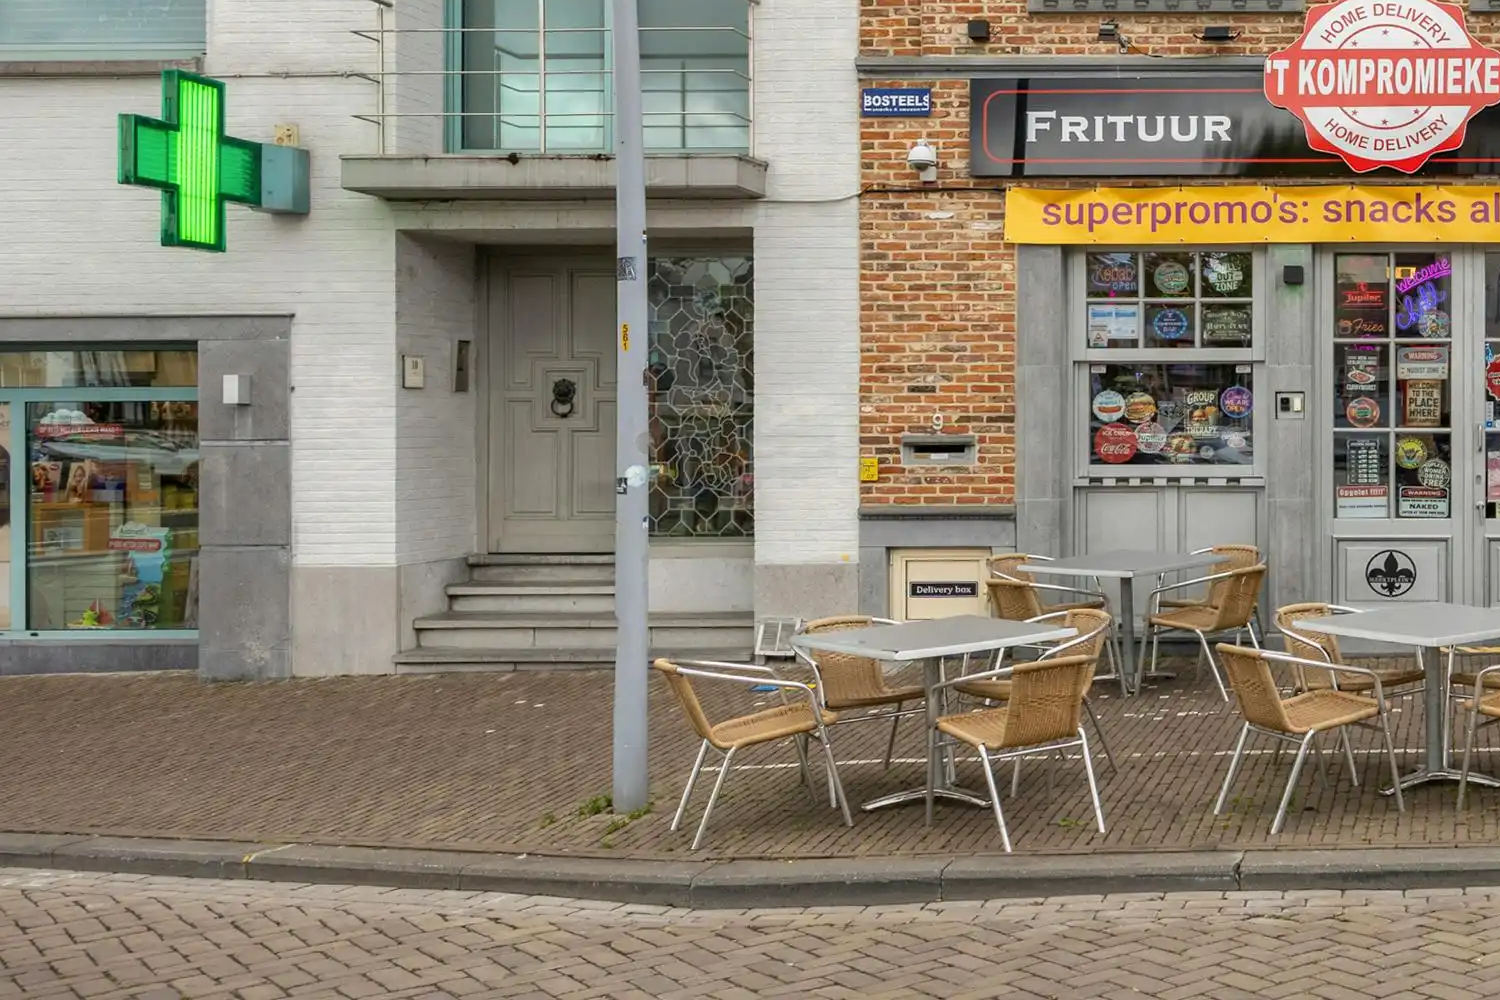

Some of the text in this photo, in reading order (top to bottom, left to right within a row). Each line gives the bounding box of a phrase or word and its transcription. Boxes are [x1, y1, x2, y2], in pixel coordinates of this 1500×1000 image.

[1320, 3, 1450, 44] HOME DELIVERY
[1298, 58, 1500, 96] KOMPROMIEKE
[864, 95, 929, 106] BOSTEELS
[1026, 110, 1232, 143] FRITUUR
[1324, 114, 1449, 151] HOME DELIVERY
[1042, 193, 1308, 232] superpromo's:
[1323, 193, 1456, 223] snacks
[1470, 192, 1500, 223] al
[1187, 391, 1215, 404] GROUP
[1408, 398, 1440, 408] PLACE
[1408, 408, 1439, 418] WHERE
[932, 413, 944, 430] 9
[1408, 503, 1439, 511] NAKED
[916, 585, 972, 595] Delivery box
